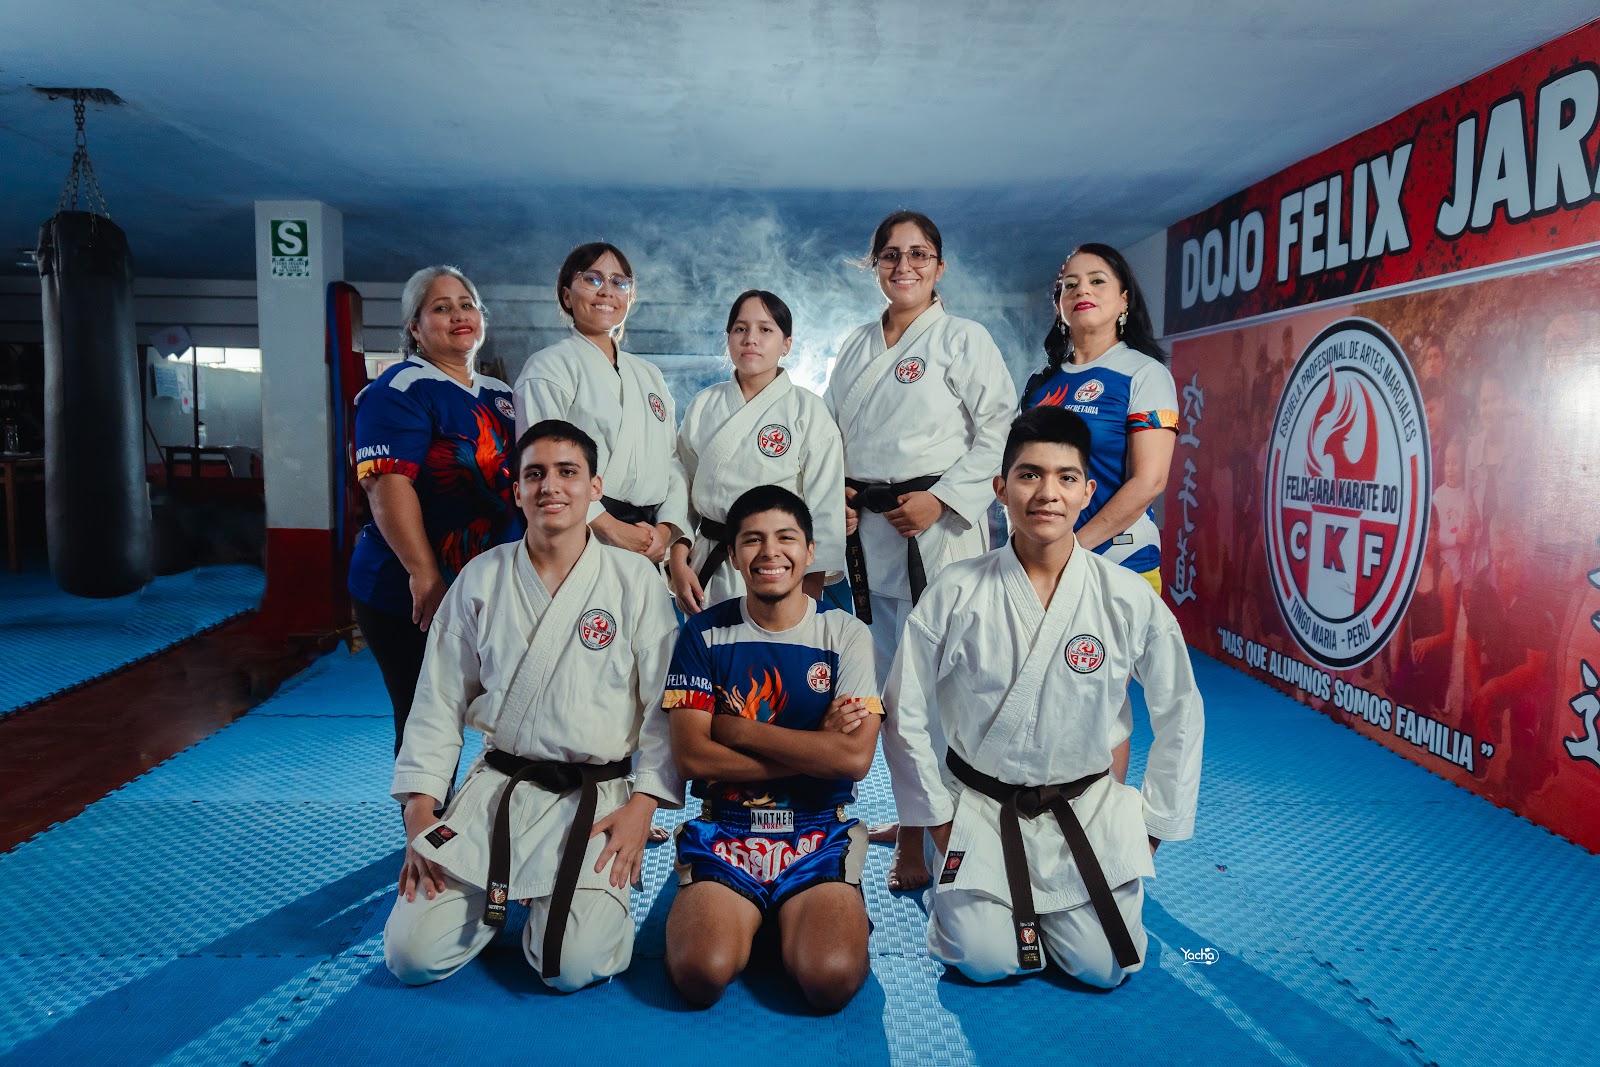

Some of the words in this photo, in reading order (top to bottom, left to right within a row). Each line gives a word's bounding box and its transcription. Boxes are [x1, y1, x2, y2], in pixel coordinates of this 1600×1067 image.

[1181, 211, 1265, 309] DOJO
[1277, 143, 1413, 283] FELIX
[1436, 68, 1600, 237] JAR
[278, 222, 302, 254] S
[1280, 384, 1303, 438] ESCUELA
[1301, 341, 1347, 390] PROFESIONAL
[1349, 341, 1359, 359] DE
[1360, 343, 1385, 375] ARTES
[1383, 363, 1417, 443] MARCIALES
[1286, 475, 1336, 506] FELIX-JARA
[1338, 480, 1380, 511] KARATE
[1382, 484, 1399, 514] DO
[1290, 520, 1309, 562] C
[1323, 524, 1349, 573] K
[1362, 532, 1385, 579] F
[1291, 595, 1312, 635] TINGO
[1311, 621, 1338, 651] MARIA
[1347, 614, 1371, 650] PERÚ
[667, 673, 688, 687] FELIX
[690, 675, 713, 692] JARA
[1246, 640, 1268, 671] QUE
[1269, 650, 1332, 701] ALUMNOS
[1334, 679, 1392, 731] SOMOS
[1395, 705, 1474, 772] FAMILIA
[751, 811, 793, 826] ANOTHER
